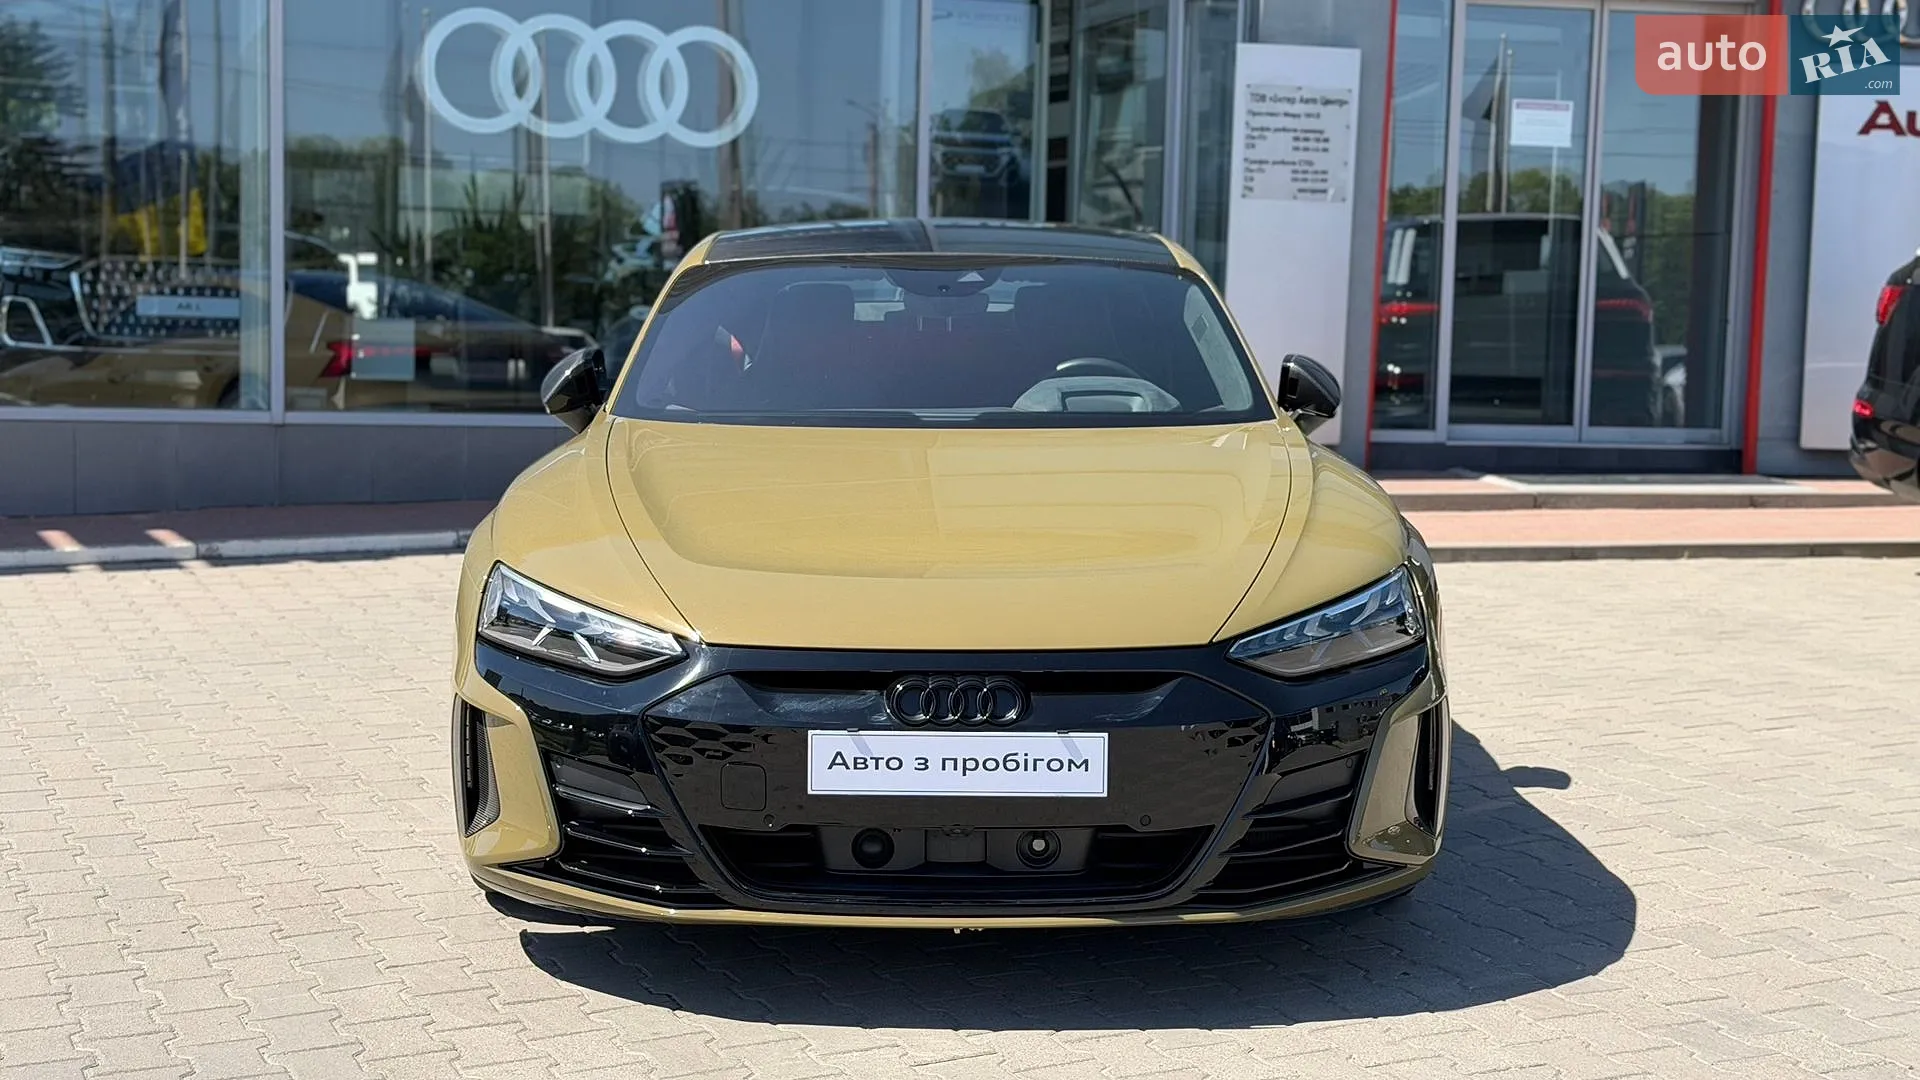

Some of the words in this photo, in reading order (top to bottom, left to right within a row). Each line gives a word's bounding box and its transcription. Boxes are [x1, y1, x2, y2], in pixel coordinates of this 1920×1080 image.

[827, 750, 904, 771] Авто
[914, 756, 930, 771] з
[941, 752, 1090, 776] пробігом
